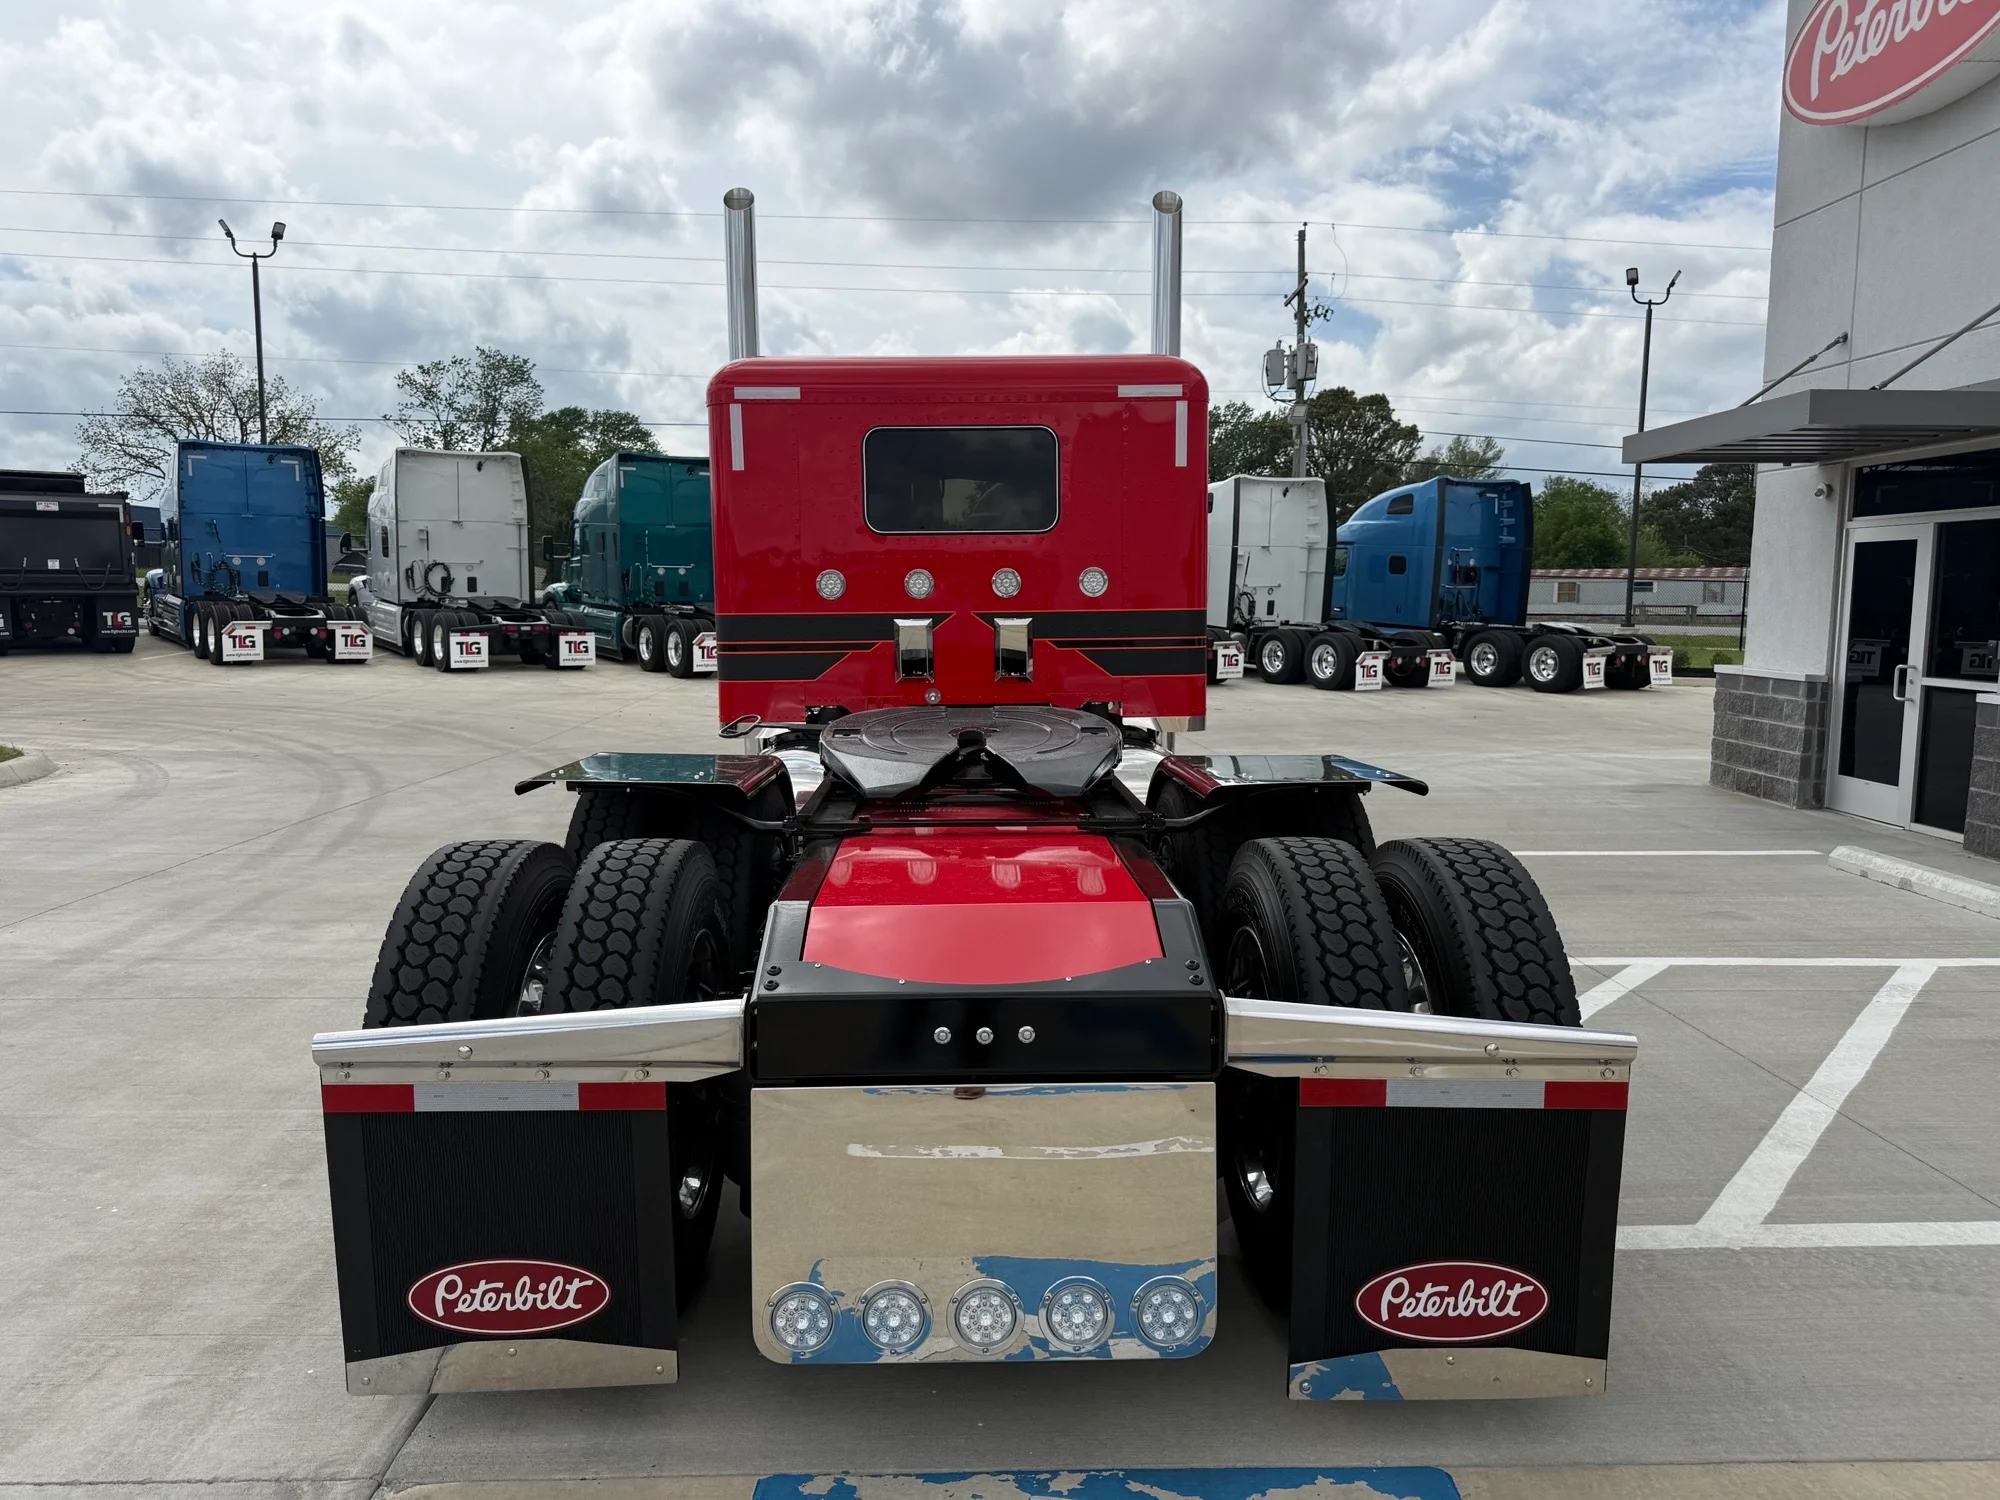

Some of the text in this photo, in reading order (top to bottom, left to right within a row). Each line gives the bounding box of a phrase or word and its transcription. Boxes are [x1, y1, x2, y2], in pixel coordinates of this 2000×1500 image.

[103, 611, 131, 626] TLG
[228, 635, 256, 648] TLG
[341, 634, 366, 647] TLG
[565, 640, 588, 653] TLG
[456, 641, 481, 655] TLG
[1222, 654, 1239, 667] TLG
[1653, 660, 1668, 673] TLG
[1360, 665, 1377, 678] TLG
[1434, 661, 1451, 674] TLG
[1586, 662, 1601, 676] TLG
[434, 1274, 594, 1317] Peterbilt
[1380, 1276, 1535, 1322] Peterbilt
